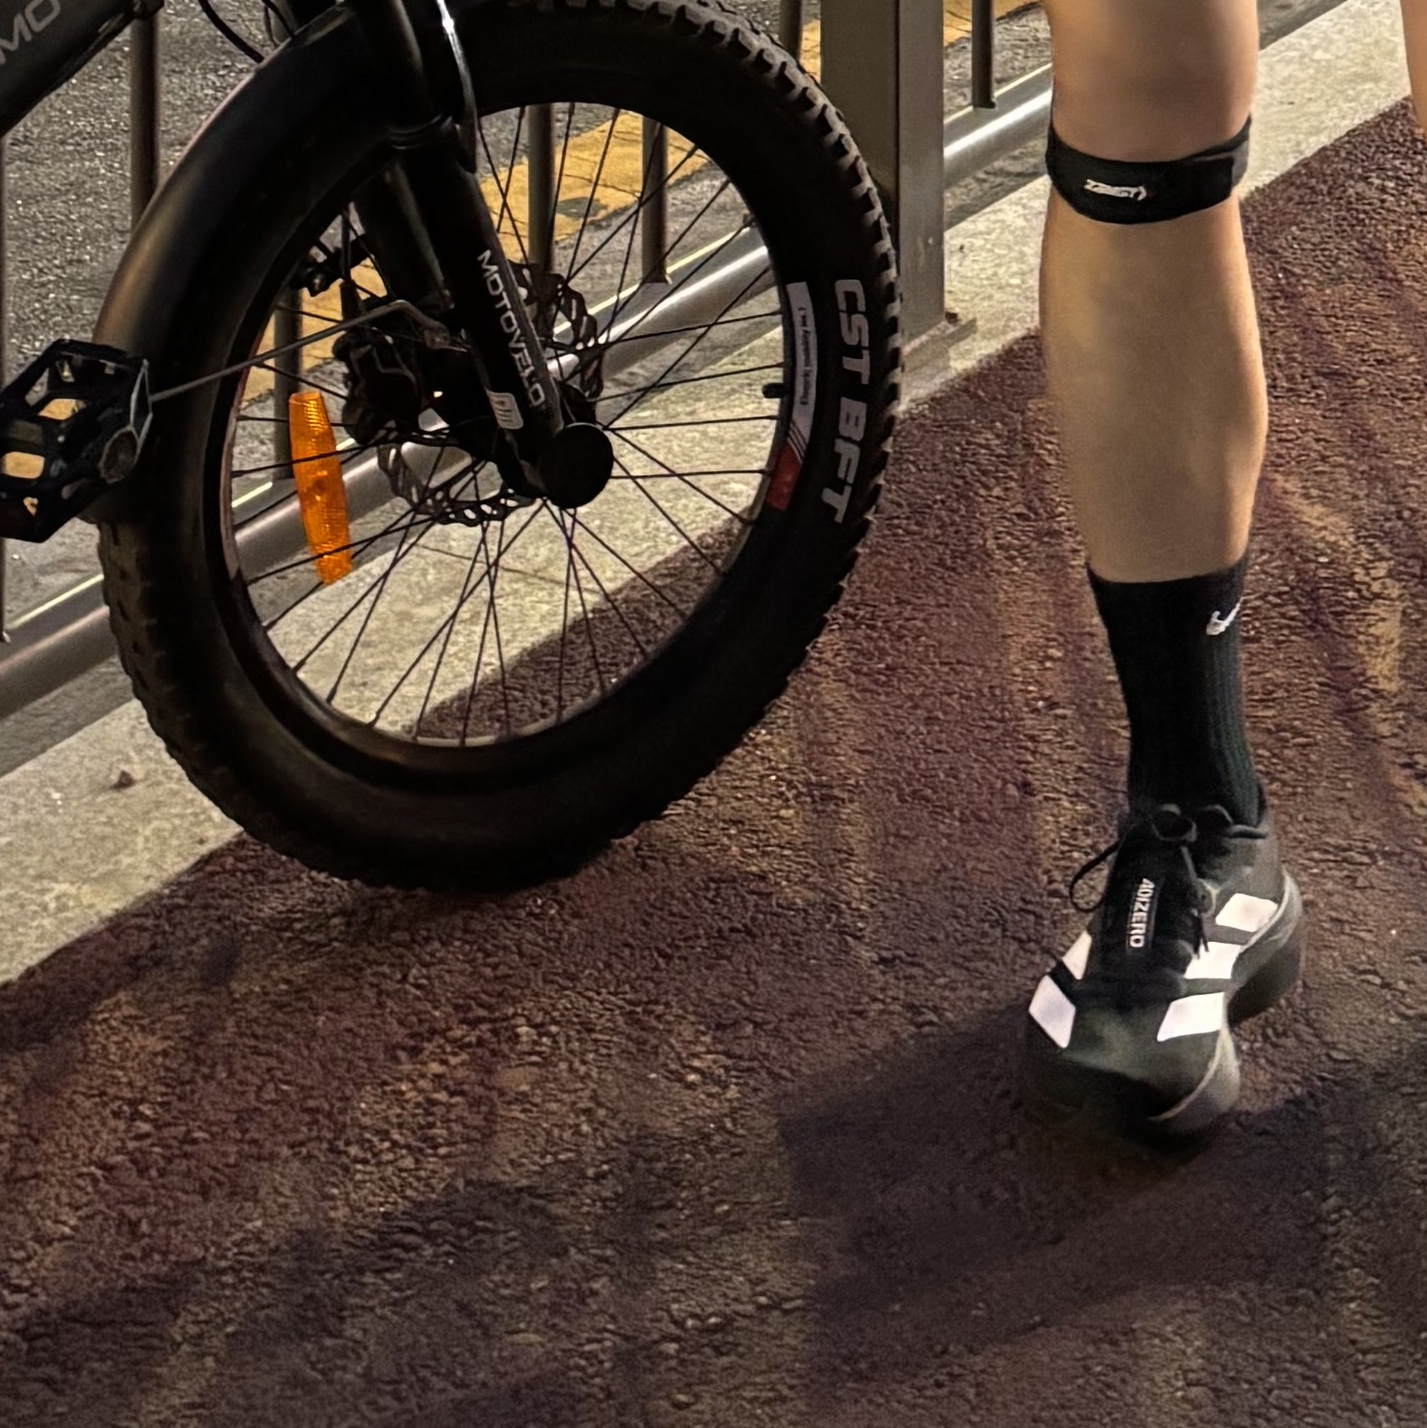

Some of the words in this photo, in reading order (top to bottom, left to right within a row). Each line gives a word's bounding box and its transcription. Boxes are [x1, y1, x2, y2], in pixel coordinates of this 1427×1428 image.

[477, 249, 545, 407] MOTOVELO
[834, 279, 870, 385] CST
[822, 396, 868, 524] BFT
[1130, 878, 1155, 948] ADIZERO
